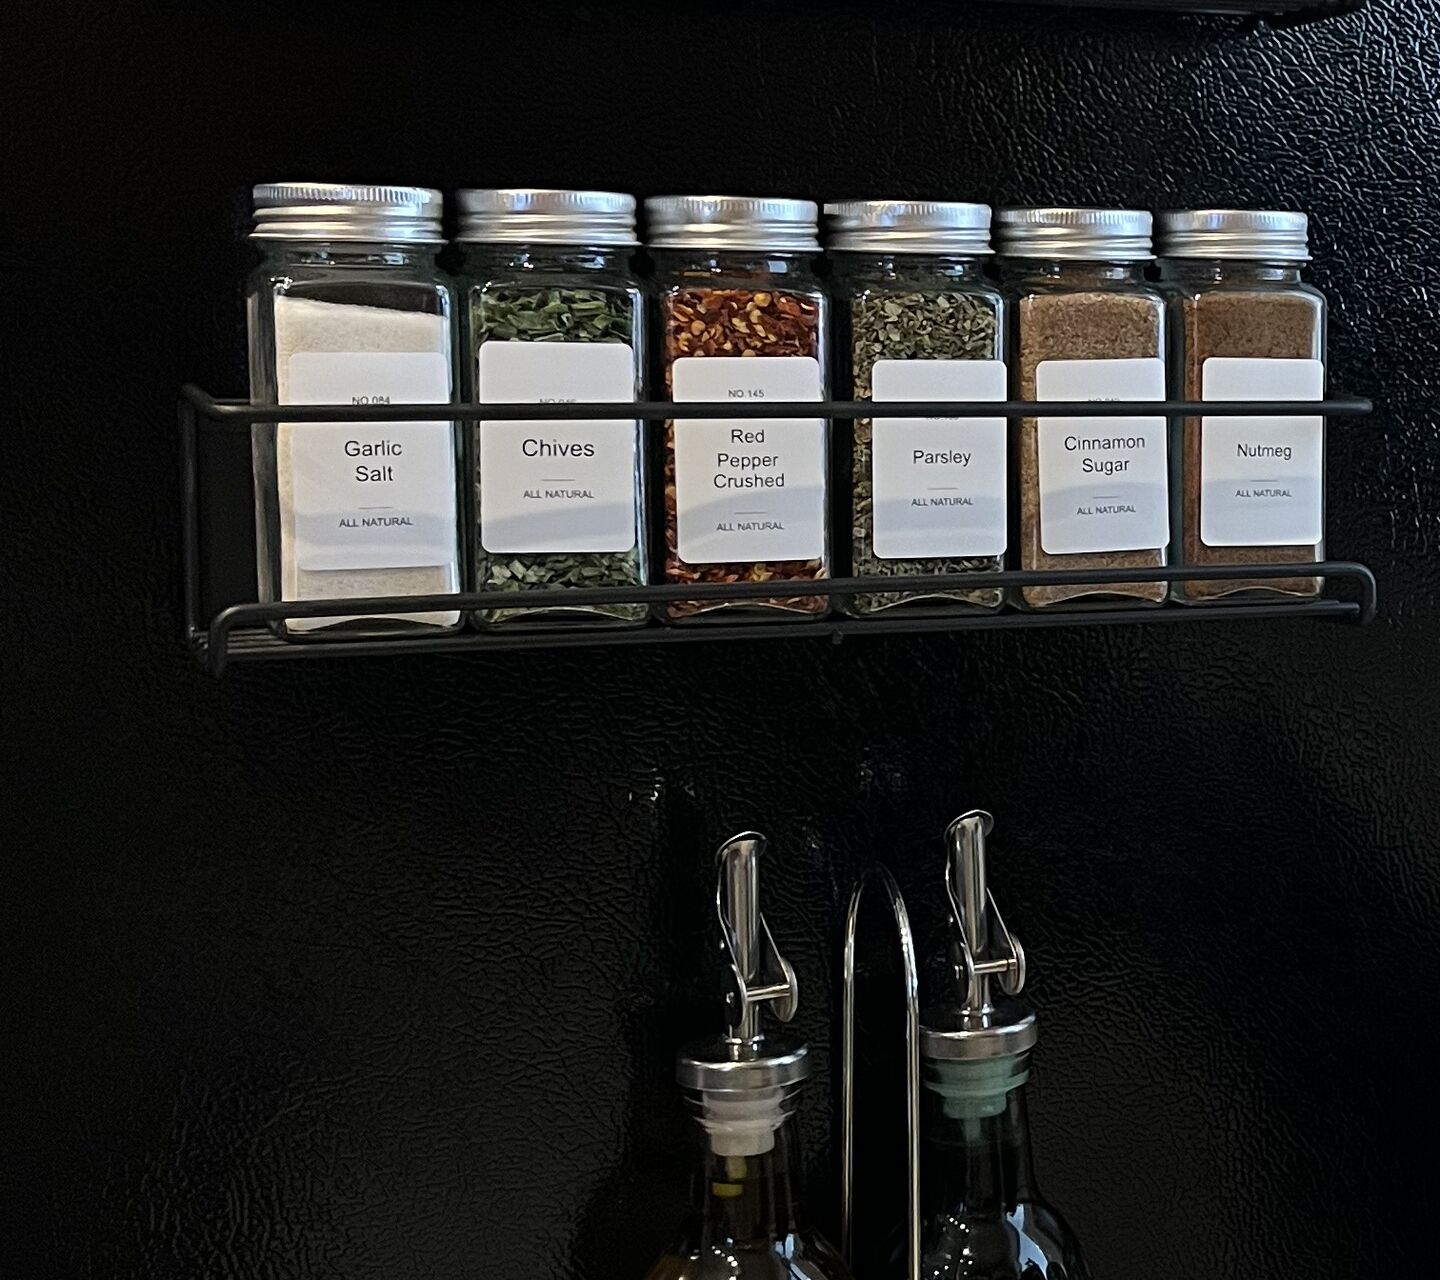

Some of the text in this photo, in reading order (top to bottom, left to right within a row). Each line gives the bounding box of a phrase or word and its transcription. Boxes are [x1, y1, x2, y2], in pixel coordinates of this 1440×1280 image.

[731, 428, 765, 444] Red
[1064, 435, 1145, 452] Cinnamon
[344, 439, 403, 457] Garlic
[522, 438, 595, 457] Chives
[1237, 443, 1292, 461] Nutmeg
[717, 452, 779, 471] Pepper
[913, 449, 972, 468] Parsley
[1082, 457, 1130, 476] Sugar
[355, 465, 394, 483] Salt
[713, 472, 785, 489] Crushed
[522, 489, 595, 499] ALL NATURAL
[1234, 488, 1293, 498] ALL NATURAL
[910, 497, 974, 507] ALL NATURAL
[1076, 505, 1137, 516] ALL NATURAL
[338, 517, 413, 528] ALL NATURAL
[715, 521, 785, 532] ALL NATURAL
